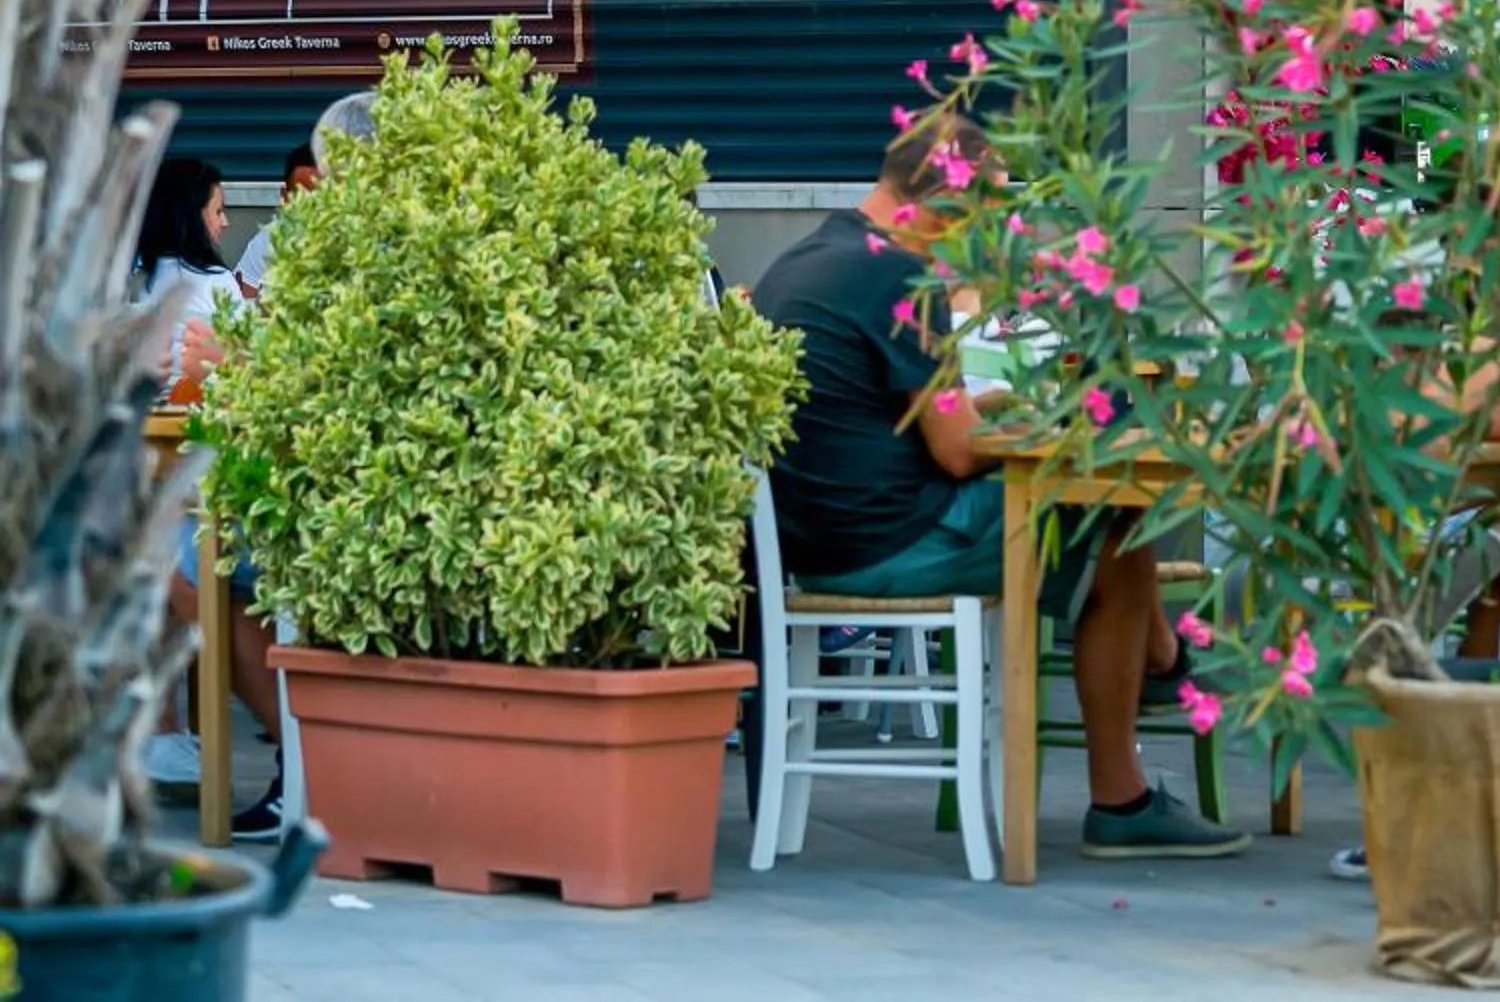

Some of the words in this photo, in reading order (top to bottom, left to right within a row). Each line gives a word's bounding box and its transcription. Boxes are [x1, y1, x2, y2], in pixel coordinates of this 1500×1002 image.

[222, 35, 256, 50] Nikos
[257, 33, 293, 50] Greek
[294, 35, 341, 49] Taverna
